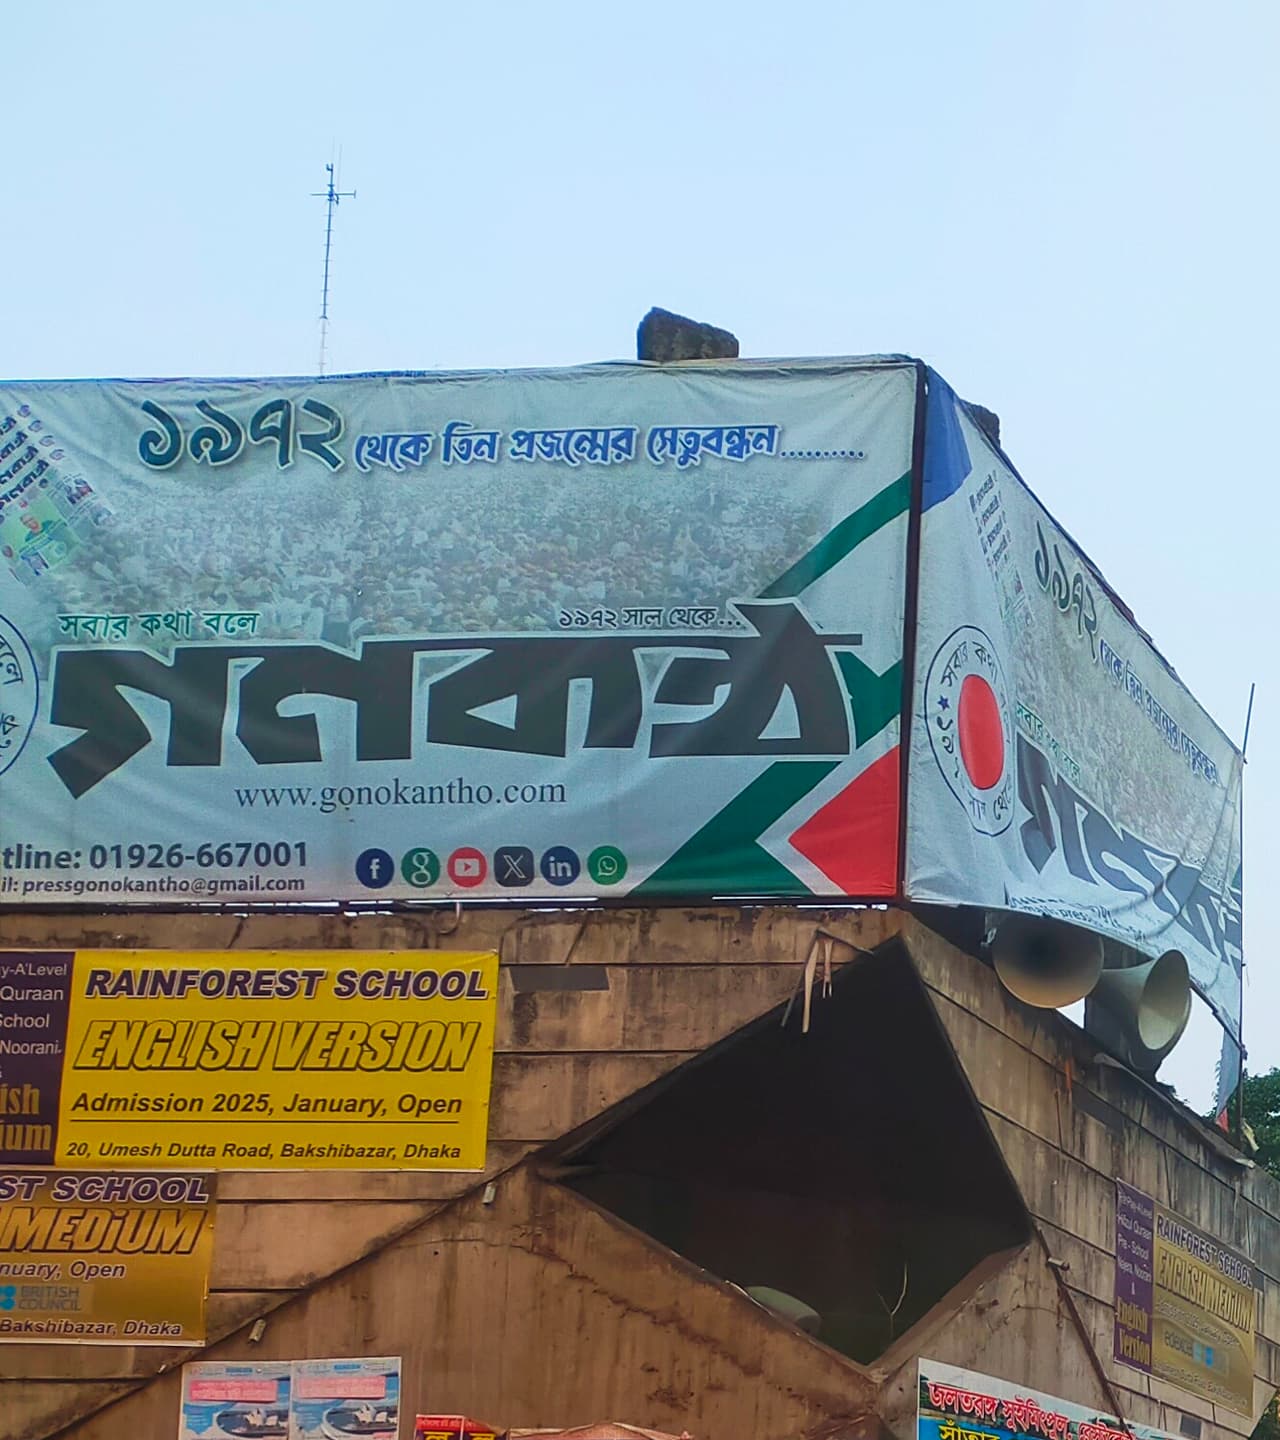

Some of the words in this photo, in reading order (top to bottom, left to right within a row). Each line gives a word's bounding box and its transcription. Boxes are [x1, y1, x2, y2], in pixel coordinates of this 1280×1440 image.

[138, 398, 345, 472] ১৯৭২
[354, 431, 436, 472] থেকে
[440, 421, 500, 467] তিন
[509, 425, 637, 466] প্রজন্মের
[57, 612, 131, 641] সবার
[138, 610, 194, 637] কথা
[202, 610, 261, 635] বলে
[559, 609, 618, 629] ১৯৭২
[622, 606, 664, 627] সাল
[234, 777, 567, 813] www.gonokantho.com
[2, 843, 81, 870] tline:
[89, 841, 308, 870] 01926-667001
[1, 876, 18, 893] il:
[22, 874, 305, 896] pressgonokantho@gmail.com
[1, 963, 67, 978] y-A'Level
[1, 986, 64, 1001] Quraan
[84, 968, 327, 1000] RAINFOREST
[333, 969, 489, 1000] SCHOOL
[72, 1020, 276, 1071] ENGLISH
[272, 1020, 481, 1071] VERSION
[0, 1084, 40, 1115] ish
[71, 1092, 204, 1113] Admission
[212, 1093, 274, 1116] 2025,
[283, 1093, 388, 1117] January,
[398, 1094, 462, 1117] Open
[0, 1121, 52, 1151] ium
[66, 1142, 92, 1159] 20,
[99, 1142, 162, 1157] Umesh
[167, 1143, 216, 1157] Dutta
[222, 1143, 274, 1159] Road,
[280, 1143, 397, 1160] Bakshibazar,
[403, 1144, 461, 1158] Dhaka
[0, 1176, 46, 1201] ST
[52, 1176, 209, 1203] SCHOOL
[0, 1263, 61, 1280] nuary,
[70, 1260, 125, 1280] Open
[1218, 1249, 1253, 1290] SCHOOL
[20, 1286, 80, 1298] BRITISH
[18, 1299, 82, 1312] COUNCIL
[1, 1319, 117, 1335] Bakshibazar,
[123, 1321, 182, 1336] Dhaka
